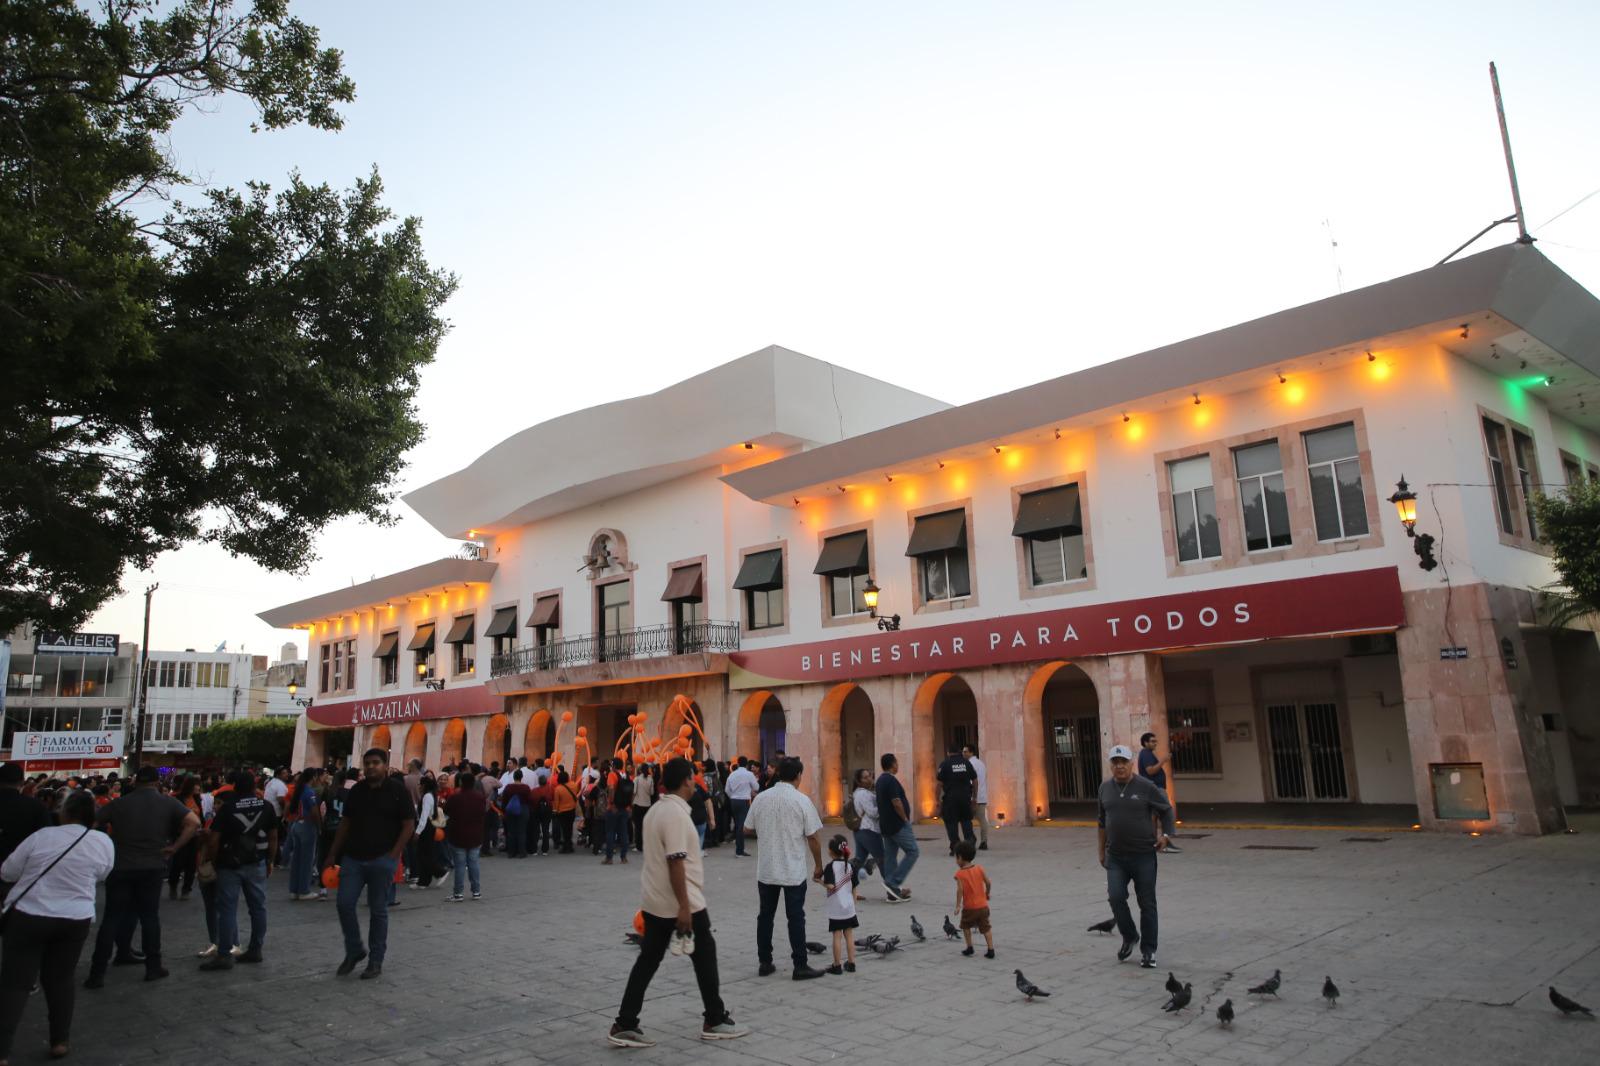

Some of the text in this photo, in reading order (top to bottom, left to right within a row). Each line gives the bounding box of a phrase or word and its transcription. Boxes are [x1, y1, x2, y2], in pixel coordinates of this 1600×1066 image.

[40, 633, 114, 647] LATELIER
[802, 603, 1250, 671] BIENESTAR PARA TODOS
[361, 696, 420, 721] MAZATLÁN
[43, 736, 107, 746] FARMACIA
